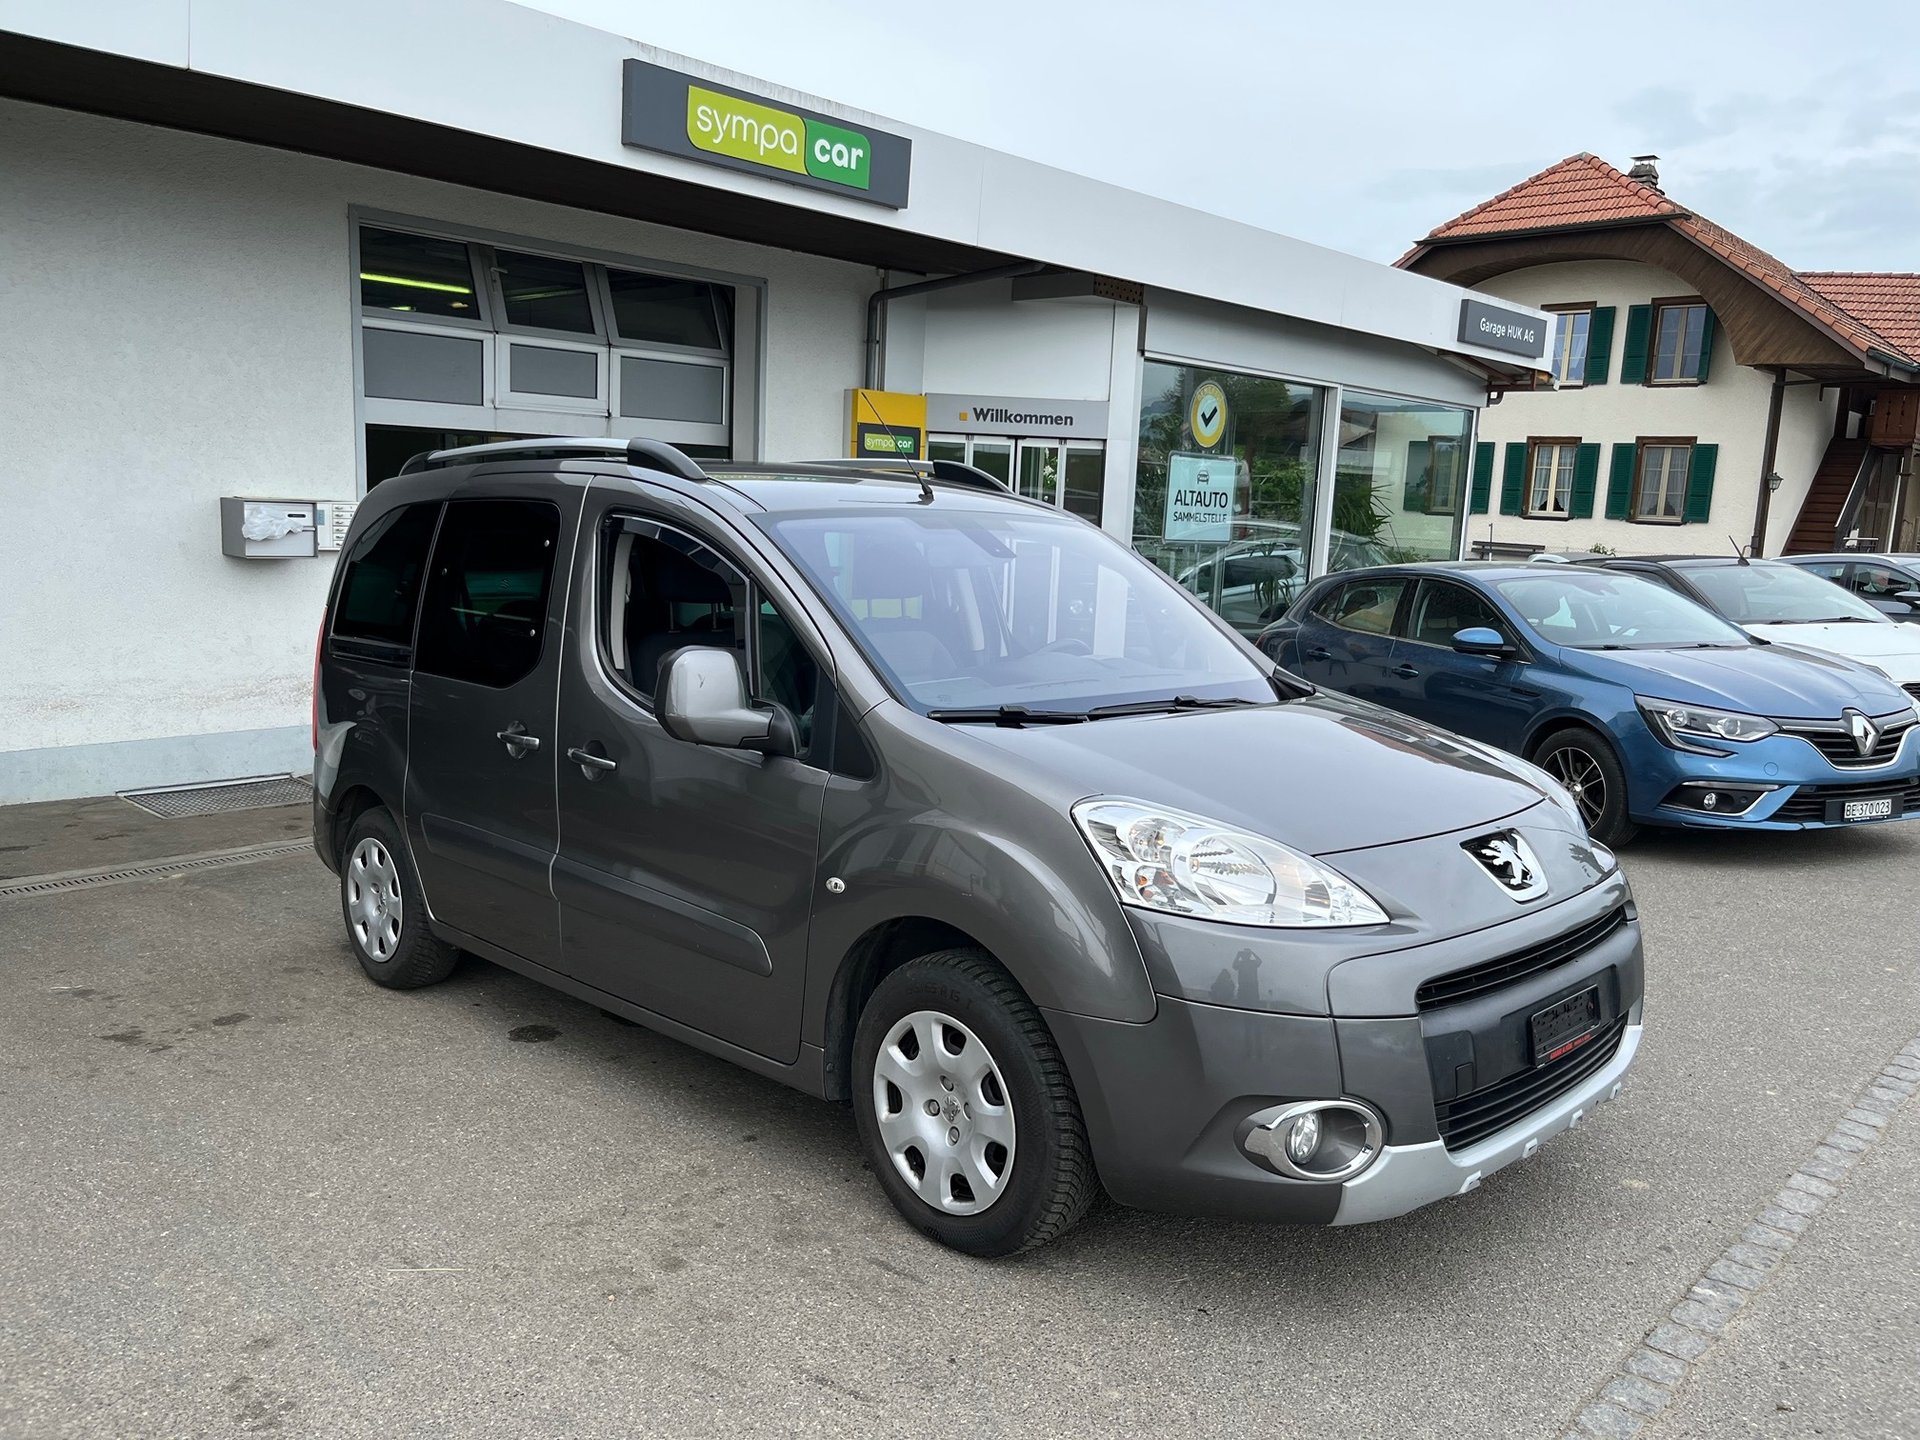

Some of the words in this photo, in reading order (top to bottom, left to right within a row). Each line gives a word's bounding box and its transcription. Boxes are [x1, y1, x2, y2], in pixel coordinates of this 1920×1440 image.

[696, 105, 797, 156] sympa
[814, 138, 863, 170] car
[1480, 317, 1505, 337] Garage
[1507, 324, 1523, 340] HUK
[1523, 329, 1534, 343] AG
[972, 407, 1073, 426] Willkommen
[866, 437, 894, 448] sympa
[897, 440, 912, 448] car
[1174, 489, 1228, 508] ALTAUTO
[1173, 511, 1228, 523] SAMMELSTELLE
